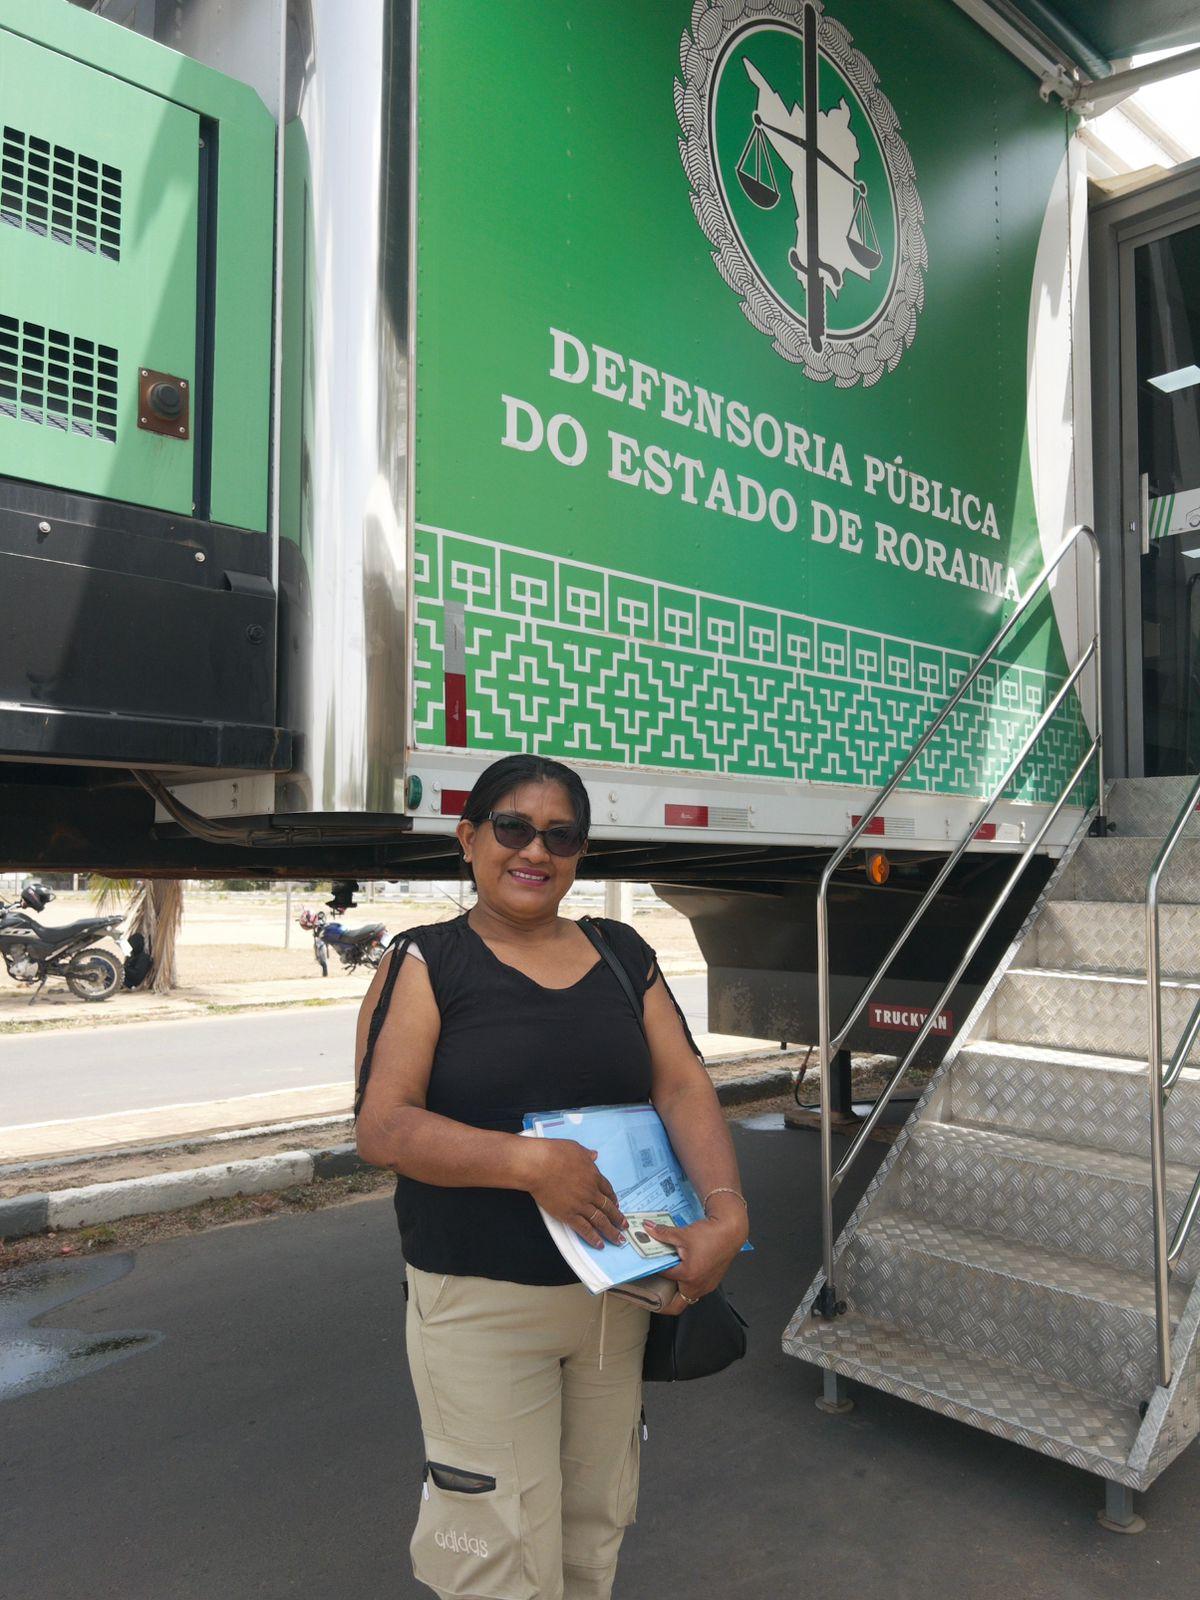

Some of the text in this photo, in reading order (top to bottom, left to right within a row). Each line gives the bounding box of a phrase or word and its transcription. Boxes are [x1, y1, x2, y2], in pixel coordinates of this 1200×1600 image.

[501, 394, 1022, 602] DO ESTADO DE RORAIMA
[549, 327, 1000, 540] DEFENSORIA PÚBLICA
[434, 1529, 488, 1558] adidas
